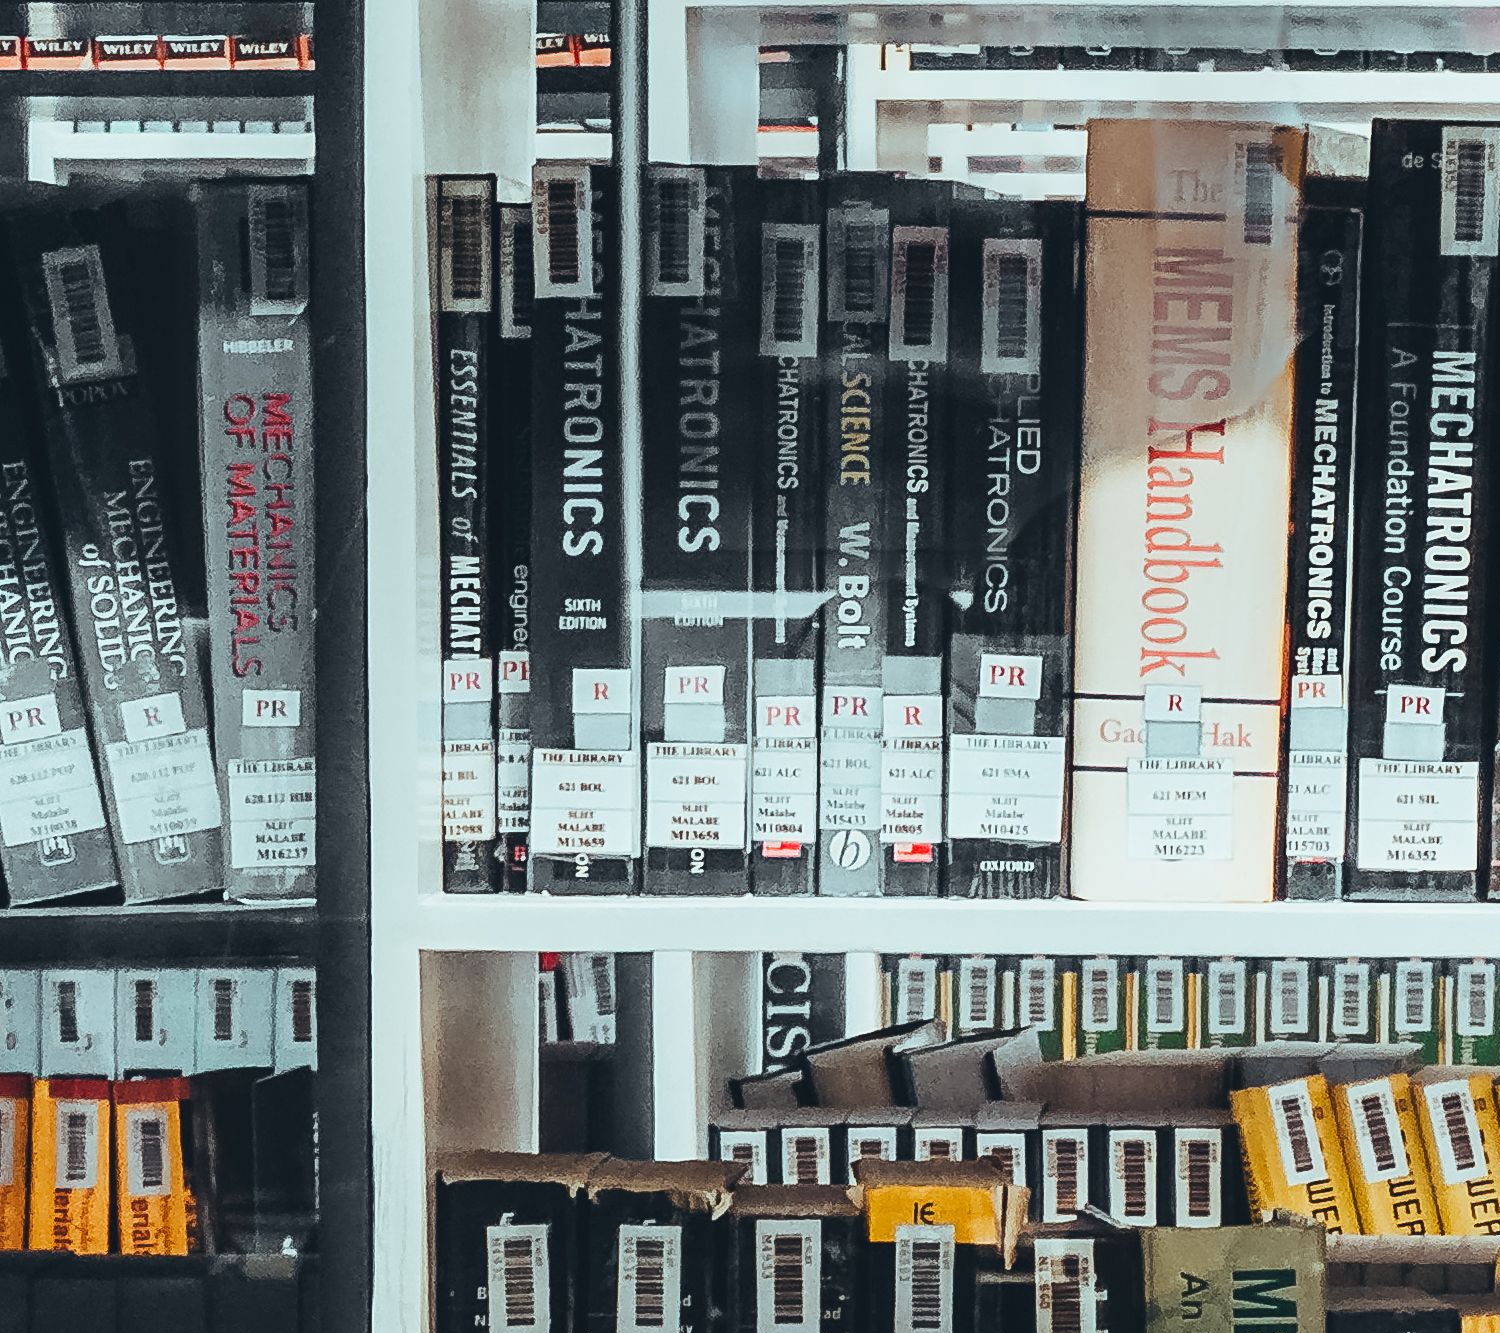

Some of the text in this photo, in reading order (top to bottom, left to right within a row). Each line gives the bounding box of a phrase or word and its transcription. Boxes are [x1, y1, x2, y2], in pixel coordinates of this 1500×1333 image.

[33, 39, 83, 56] WILEY
[451, 349, 479, 540] ESSENTIALS of
[1139, 248, 1233, 678] MEMS Handbook
[262, 393, 298, 634] MECHANICS
[1306, 399, 1338, 639] MECHATRONICS
[1378, 348, 1419, 671] A Foundation Course
[1421, 350, 1477, 674] MECHATRONICS
[224, 394, 263, 679] OF MATERIALS
[564, 598, 601, 613] SIXTH
[838, 521, 870, 649] W. Bolt
[559, 615, 607, 629] EDITION
[449, 671, 482, 692] PR
[1399, 694, 1432, 715] PR
[255, 699, 289, 718] PR
[569, 753, 625, 764] LIBRARY
[980, 860, 1035, 873] OXFORD
[1179, 1273, 1211, 1325] An
